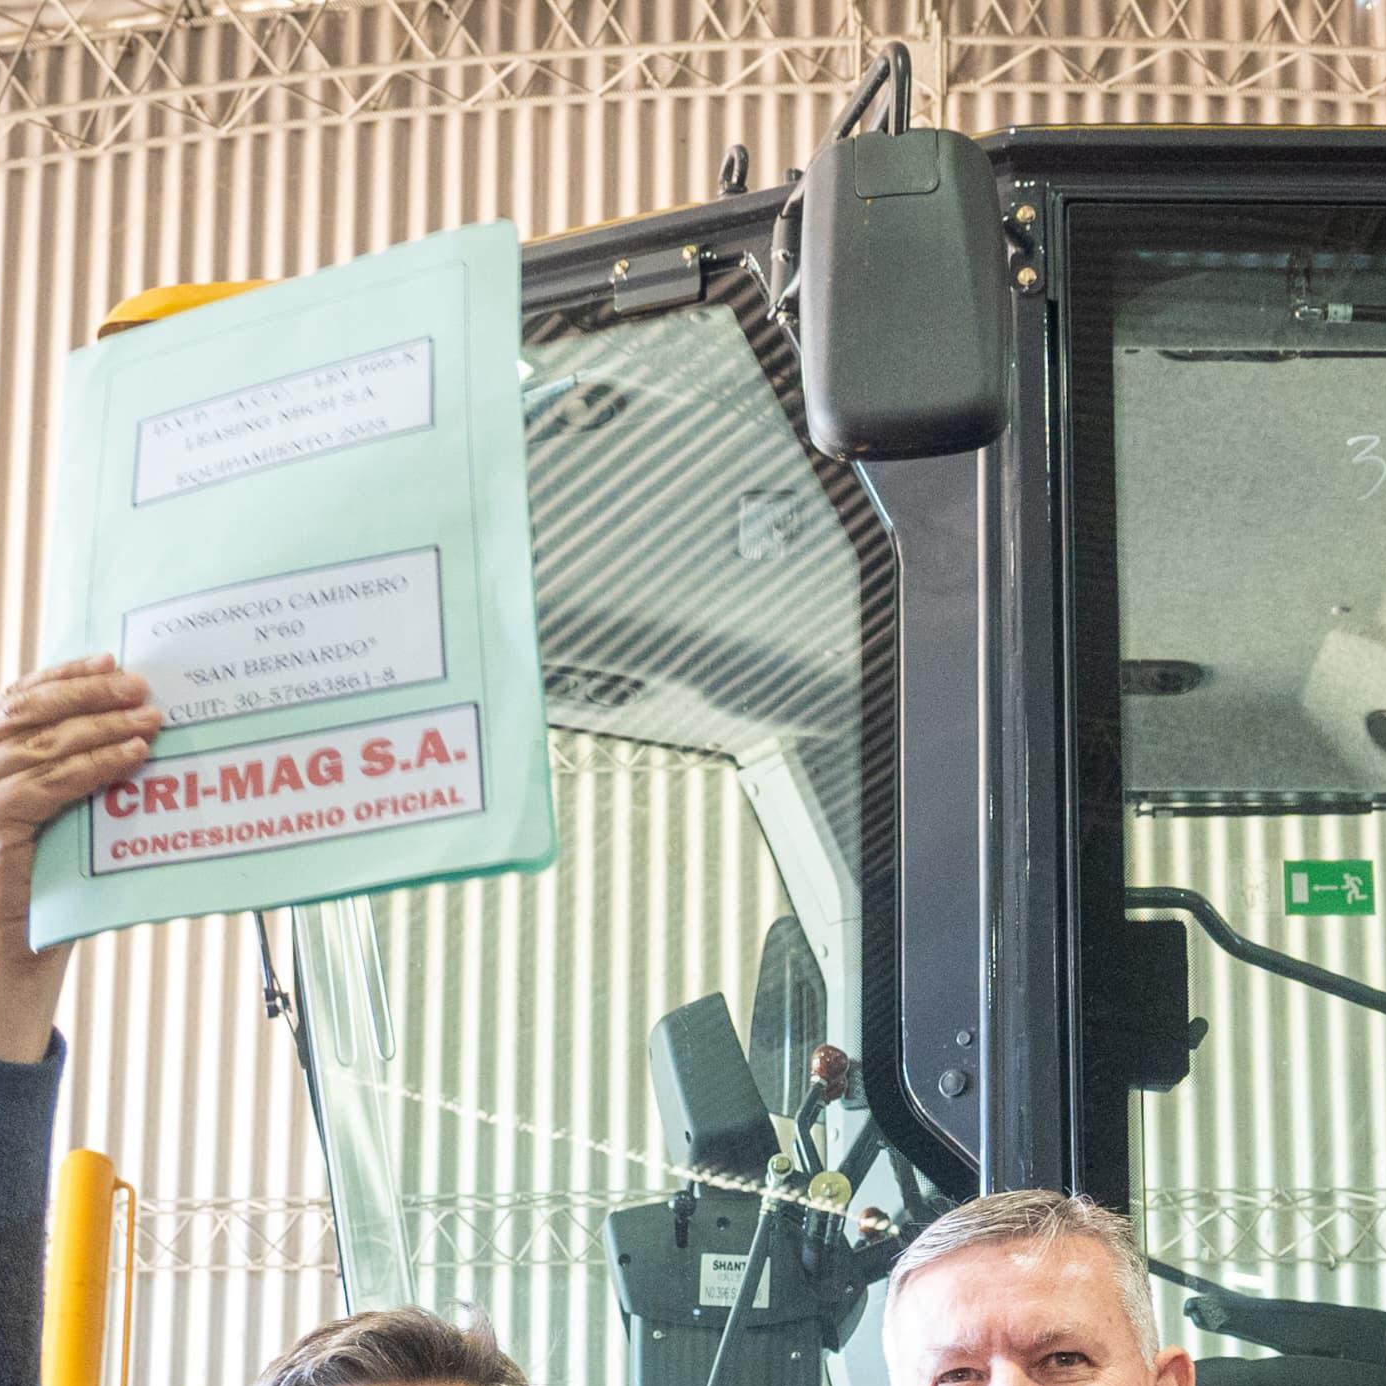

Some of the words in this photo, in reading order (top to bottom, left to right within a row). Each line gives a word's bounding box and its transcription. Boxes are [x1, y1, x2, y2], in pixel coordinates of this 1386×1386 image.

[151, 597, 283, 637] CONSORCIO
[288, 574, 409, 611] CAMINERO
[103, 746, 345, 819] CRI-MAG
[358, 727, 467, 777] S.A.
[110, 807, 345, 861] CONCESIONARIO
[354, 785, 464, 821] OFICIAL
